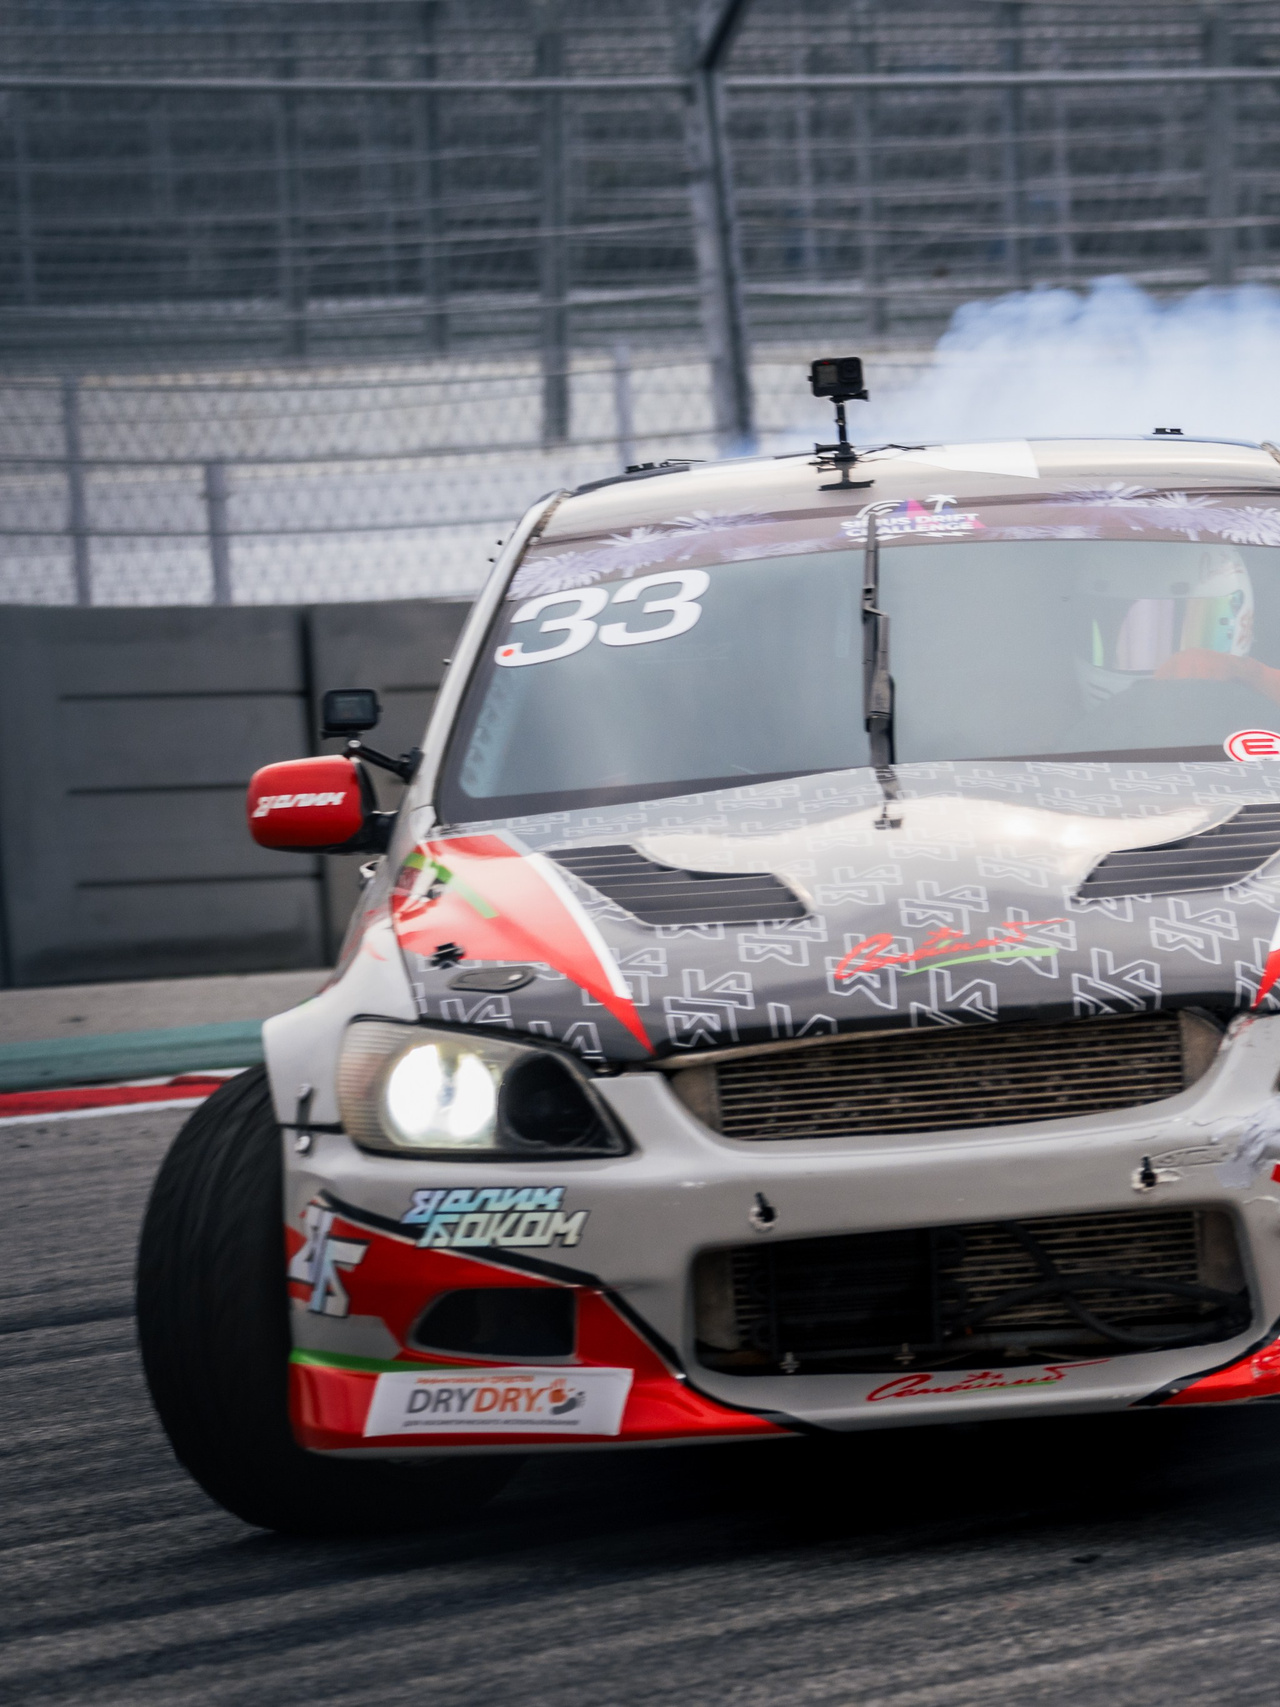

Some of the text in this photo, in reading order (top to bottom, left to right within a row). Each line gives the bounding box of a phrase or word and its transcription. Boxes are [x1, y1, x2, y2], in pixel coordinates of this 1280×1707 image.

[914, 512, 980, 525] DRIFT
[494, 569, 711, 668] 33
[415, 1210, 591, 1248] БОКОМ
